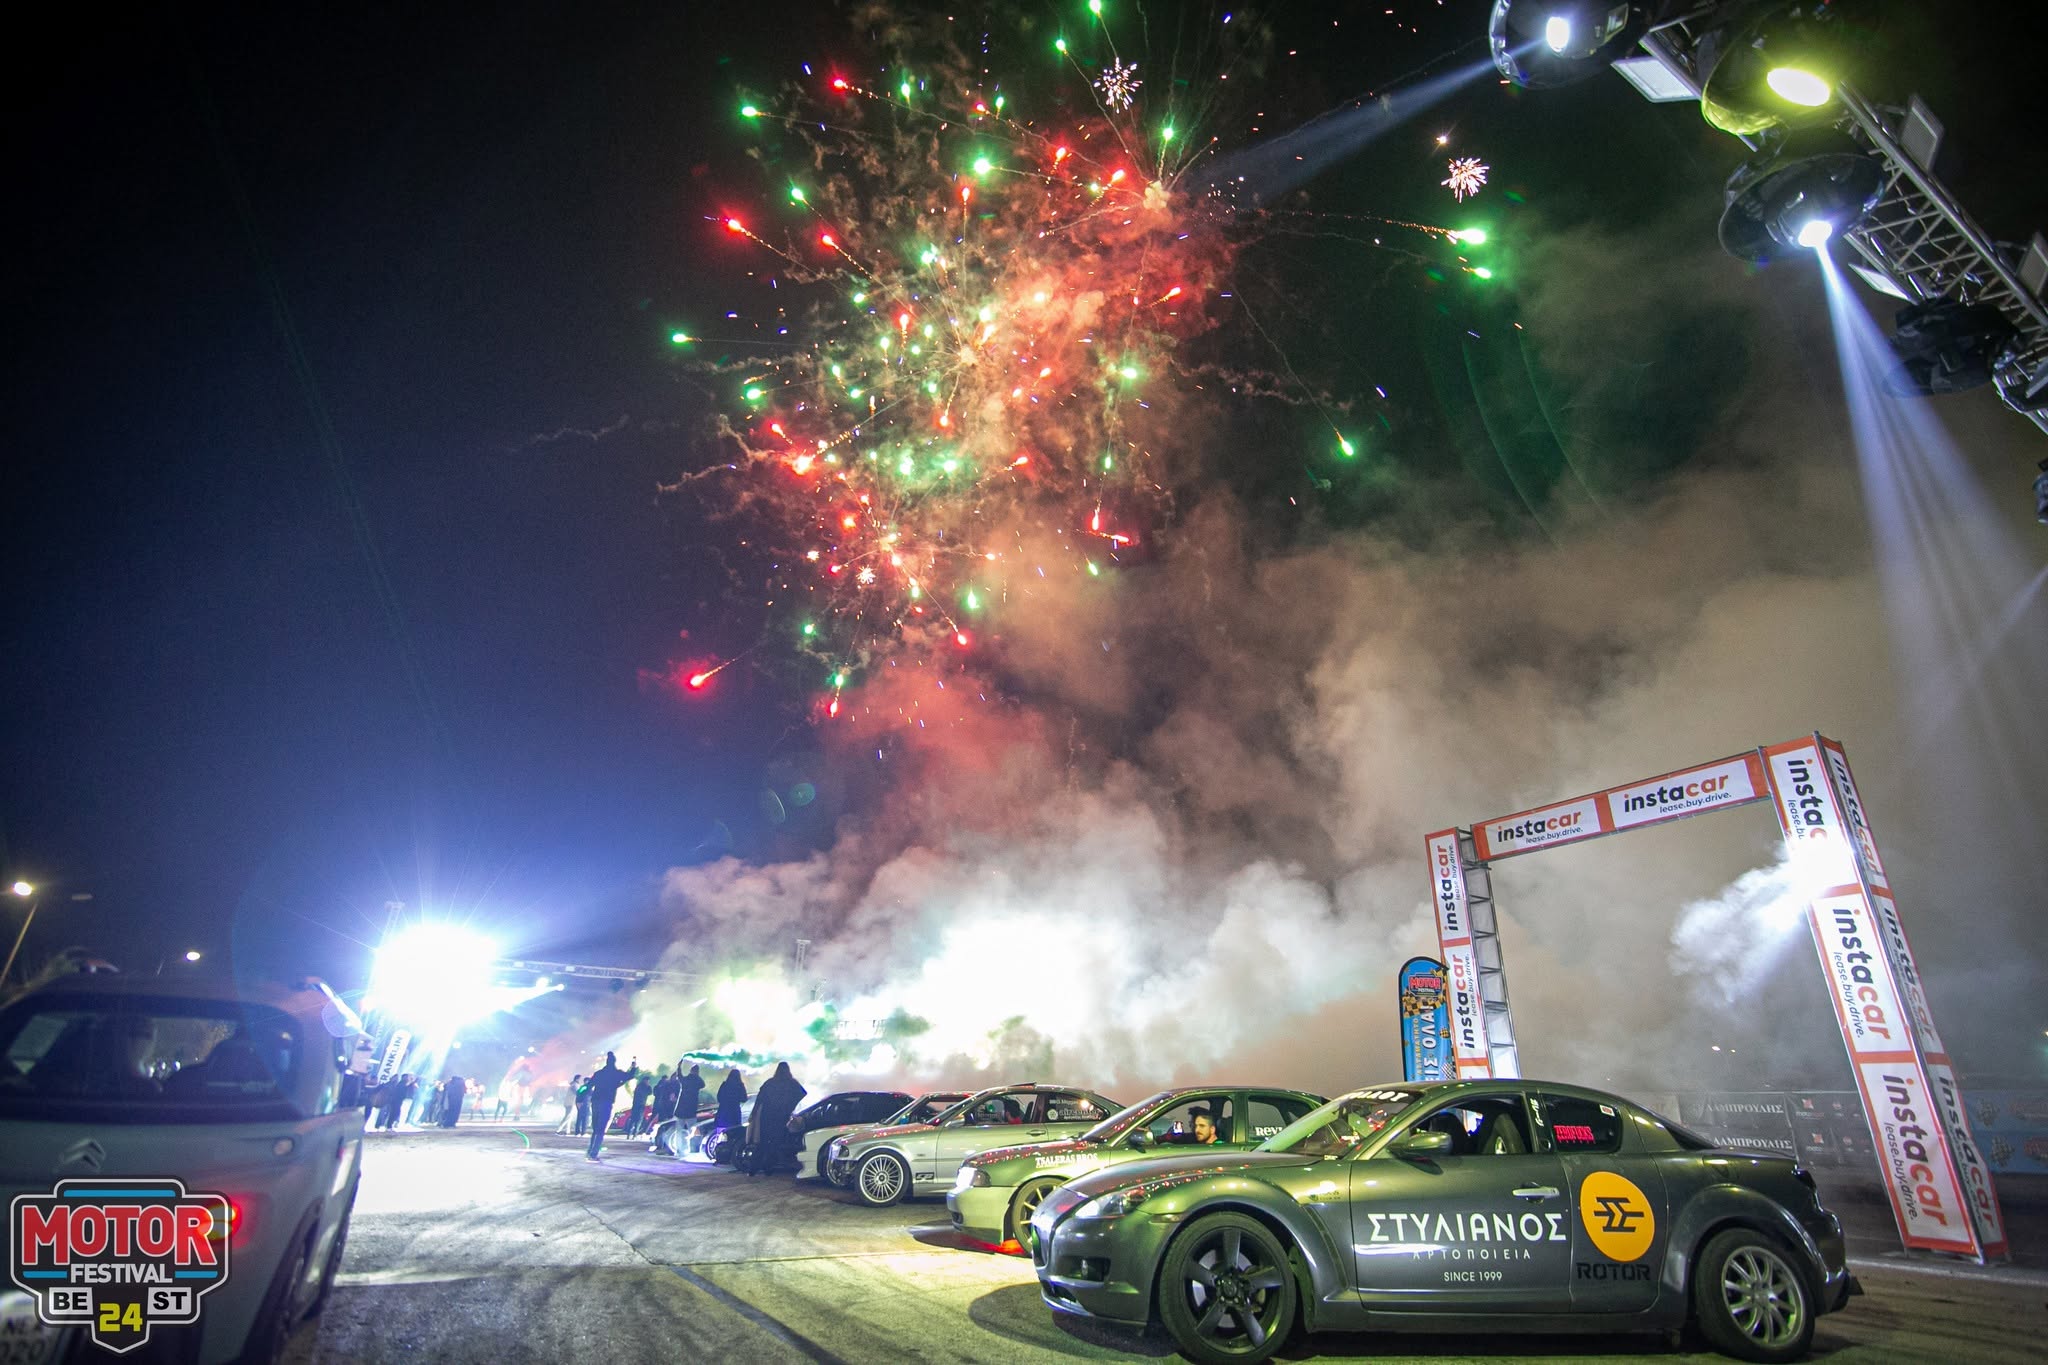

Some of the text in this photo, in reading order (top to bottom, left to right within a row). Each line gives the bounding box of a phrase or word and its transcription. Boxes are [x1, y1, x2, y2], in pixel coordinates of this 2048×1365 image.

[1624, 774, 1729, 813] instacar
[1659, 791, 1732, 814] lease.buy.drive.
[1497, 810, 1581, 842] instacar
[1525, 825, 1583, 844] lease.buy.drive.
[1437, 845, 1459, 931] instacar
[1409, 977, 1441, 989] MOTOR
[1832, 908, 1892, 1040] instacar
[1884, 907, 1935, 1041] instacar
[1453, 954, 1475, 1049] instacar
[1834, 951, 1865, 1038] lease.buy.drive.
[1713, 1136, 1793, 1150] ΛΑΜΠΡΟΥΛΗΣ
[1882, 1074, 1949, 1227] instacar
[1939, 1076, 1994, 1228] instacar
[1884, 1122, 1918, 1220] lease.buy.drive.
[1367, 1213, 1567, 1241] ΣΤΥΛΙΑΝΟΣ
[1412, 1248, 1531, 1260] ΑΡΤΟΠΟΙΕΙΑ
[1575, 1262, 1650, 1281] ROTOR
[1444, 1271, 1503, 1282] SINCE 1999
